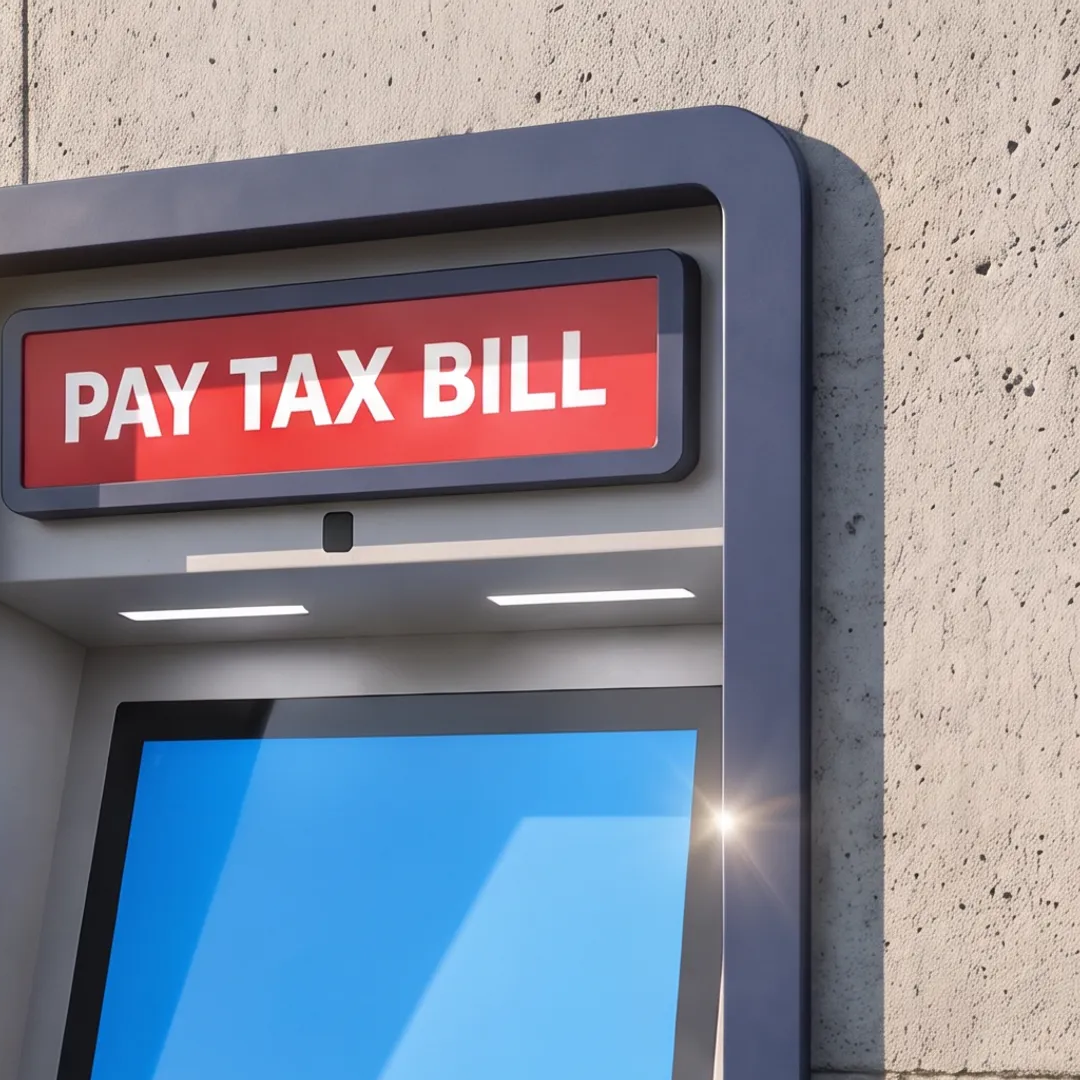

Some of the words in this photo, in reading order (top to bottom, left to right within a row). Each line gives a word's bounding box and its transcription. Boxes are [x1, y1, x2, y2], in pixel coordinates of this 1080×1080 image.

[64, 361, 209, 443] PAY
[230, 346, 395, 431] TAX
[423, 330, 607, 419] BILL
